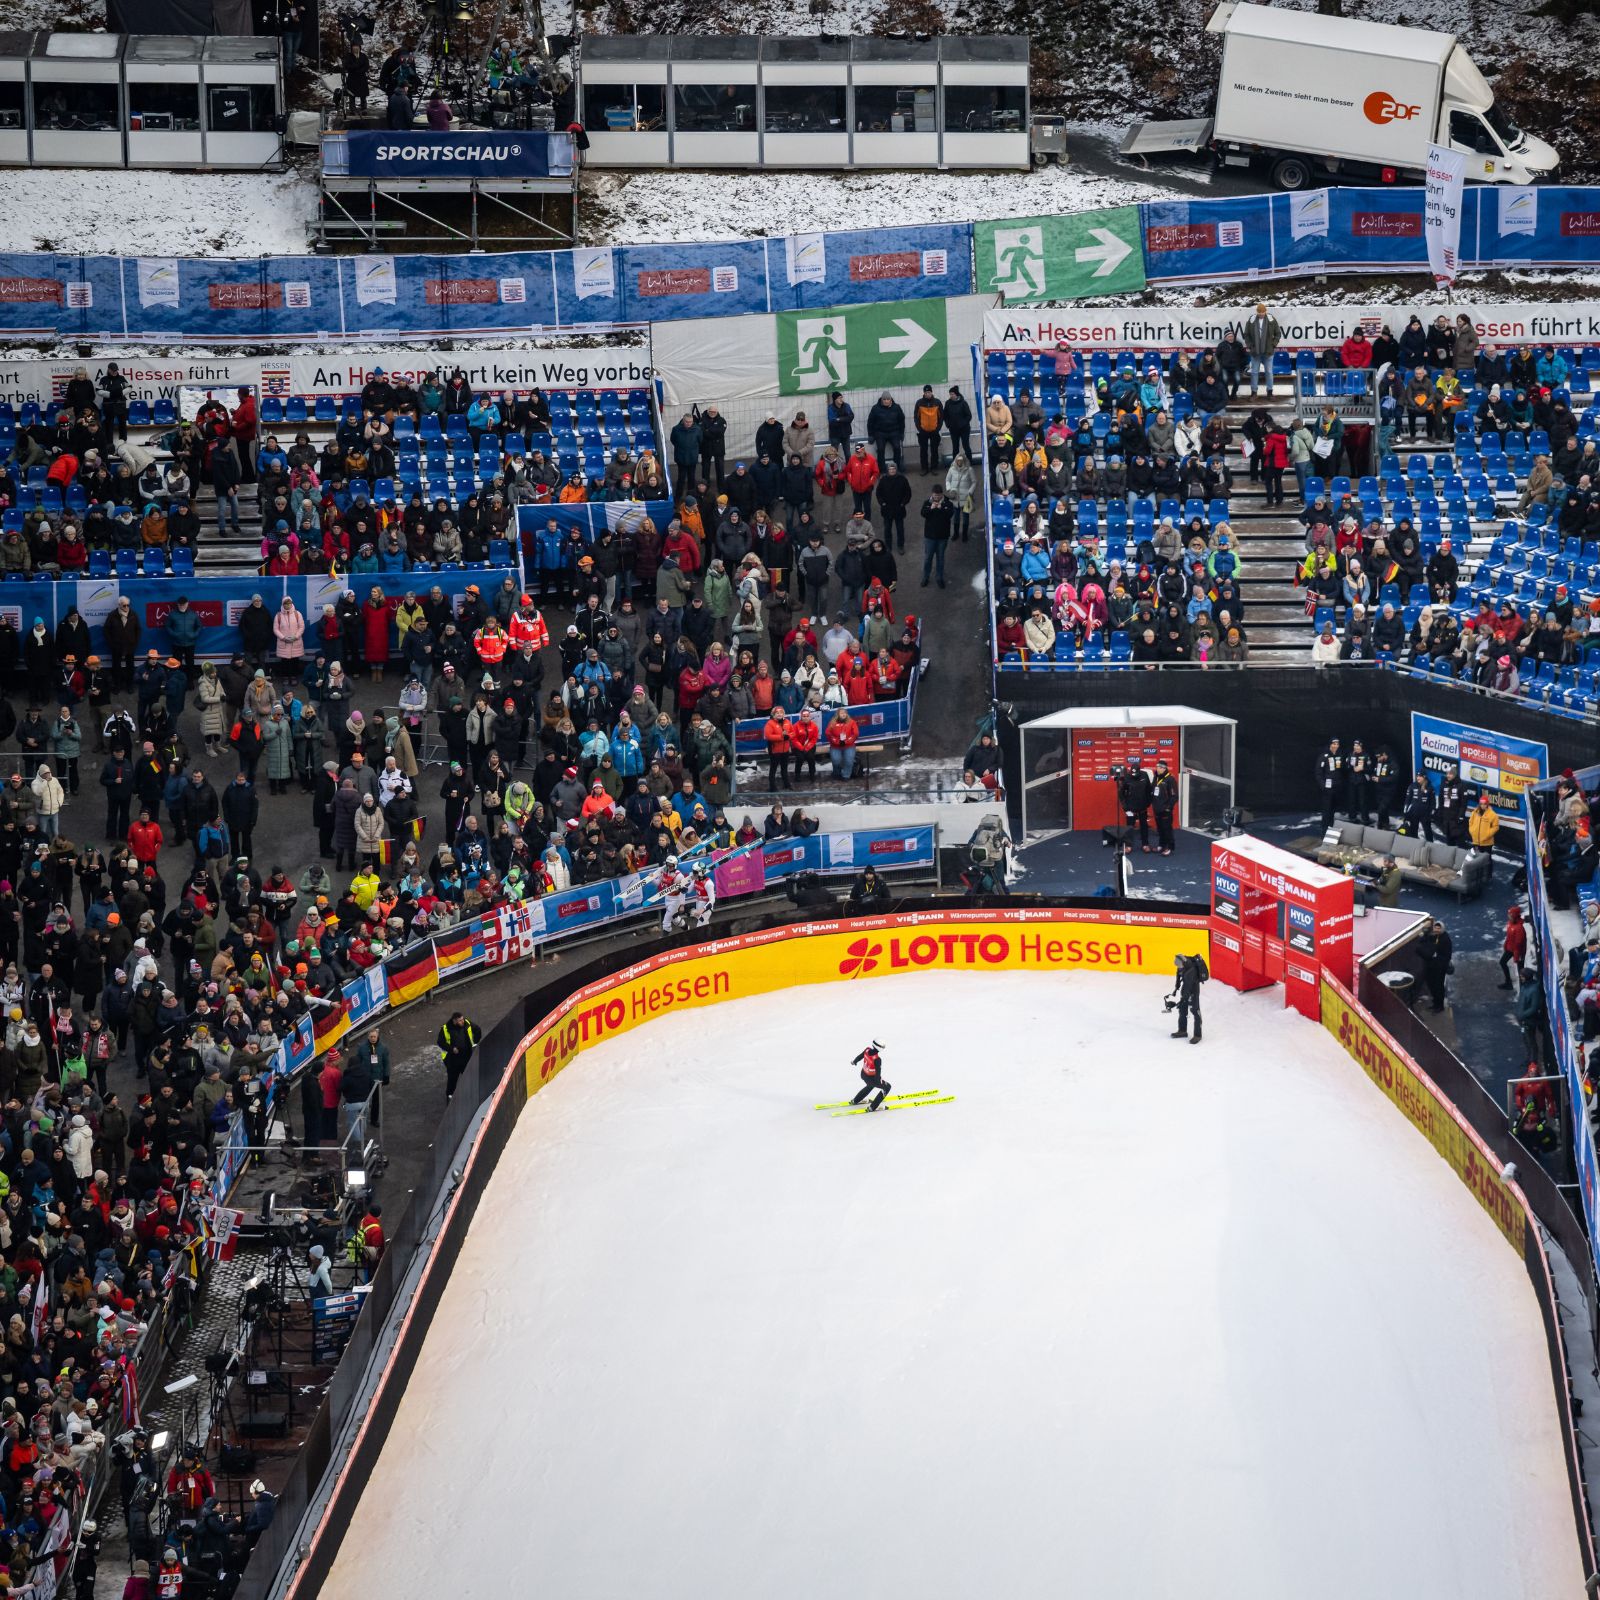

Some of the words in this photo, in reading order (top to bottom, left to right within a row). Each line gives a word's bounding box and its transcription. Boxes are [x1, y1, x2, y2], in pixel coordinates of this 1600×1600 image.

[1234, 83, 1246, 91] Mit
[1248, 85, 1262, 94] dem
[1264, 88, 1292, 98] Zweiten
[1294, 92, 1312, 100] sieht
[1330, 98, 1354, 107] besser
[1380, 100, 1422, 120] ZDF
[376, 146, 508, 160] SPORTSCHAU
[1428, 150, 1440, 162] An
[1360, 216, 1414, 234] Willingen
[1155, 228, 1208, 247] Willingen
[858, 258, 912, 276] Willingen
[0, 280, 57, 300] Willingen
[647, 272, 702, 292] Willingen
[218, 287, 274, 306] Willingen
[434, 282, 489, 302] Willingen
[1002, 323, 1031, 342] An
[1038, 322, 1116, 342] Hessen
[1122, 322, 1174, 340] führt
[1180, 320, 1222, 340] kein
[1280, 320, 1350, 340] vorbei.
[1475, 322, 1524, 337] ssen
[1530, 317, 1582, 336] führt
[189, 366, 230, 380] führt
[312, 368, 342, 387] An
[436, 364, 490, 385] führt
[493, 364, 536, 384] kein
[542, 362, 588, 387] Weg
[1422, 736, 1458, 754] Actimel
[1462, 745, 1498, 760] apotal.de
[1506, 758, 1531, 770] ARGETA
[1258, 870, 1316, 903] VIESSMANN
[850, 920, 864, 928] Heat
[866, 918, 888, 928] pumps
[896, 912, 944, 924] VIESSMANN
[950, 911, 997, 920] Wärmepumpen
[1004, 909, 1052, 921] VIESSMANN
[1078, 912, 1100, 920] pumps
[1110, 912, 1158, 924] VIESSMANN
[1162, 916, 1208, 926] Wärmepumpen
[791, 922, 839, 935] VIESSMANN
[698, 938, 740, 954] VIESSMANN
[890, 934, 1010, 968] LOTTO
[1020, 934, 1143, 966] Hessen
[559, 998, 626, 1059] LOTTO
[632, 970, 730, 1020] Hessen
[1354, 1024, 1393, 1088] LOTTO
[1396, 1066, 1434, 1136] Hessen
